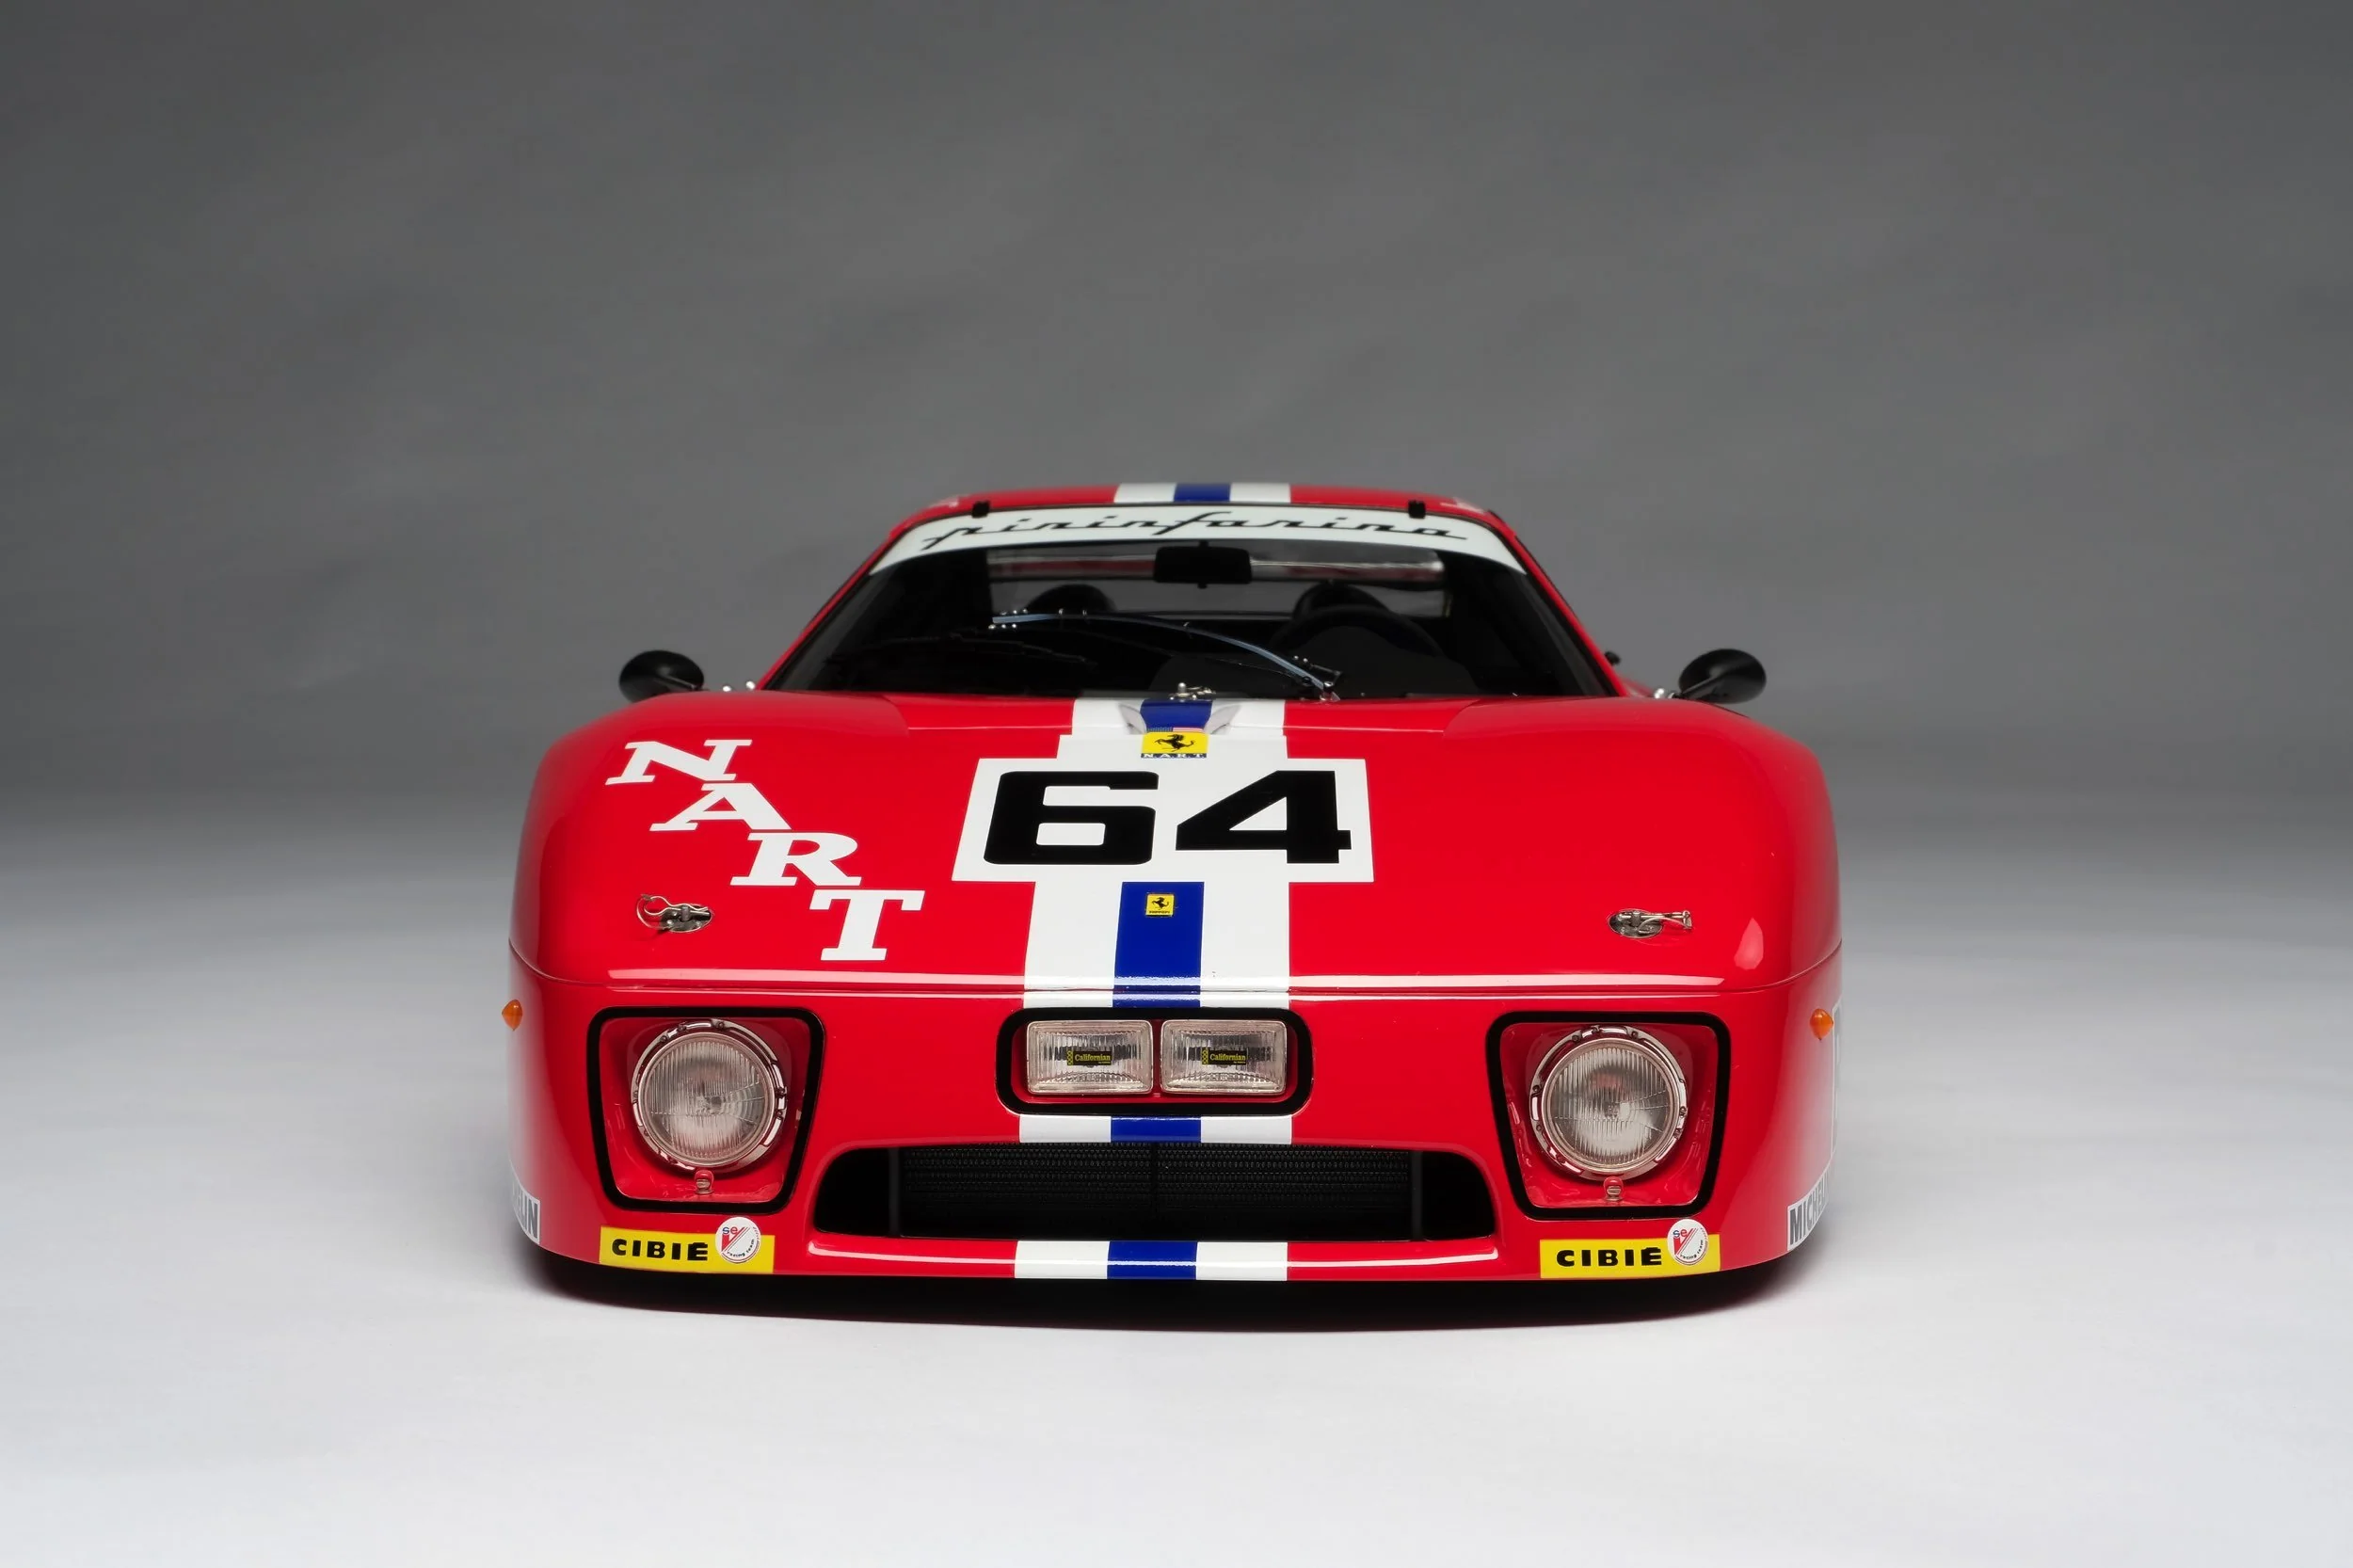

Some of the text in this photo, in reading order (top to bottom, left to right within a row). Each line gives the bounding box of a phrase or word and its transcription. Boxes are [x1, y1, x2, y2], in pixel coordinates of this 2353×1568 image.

[922, 511, 1467, 551] pininfarina
[984, 770, 1352, 865] 64
[1074, 1053, 1112, 1062] Californian
[1209, 1052, 1246, 1062] Californian
